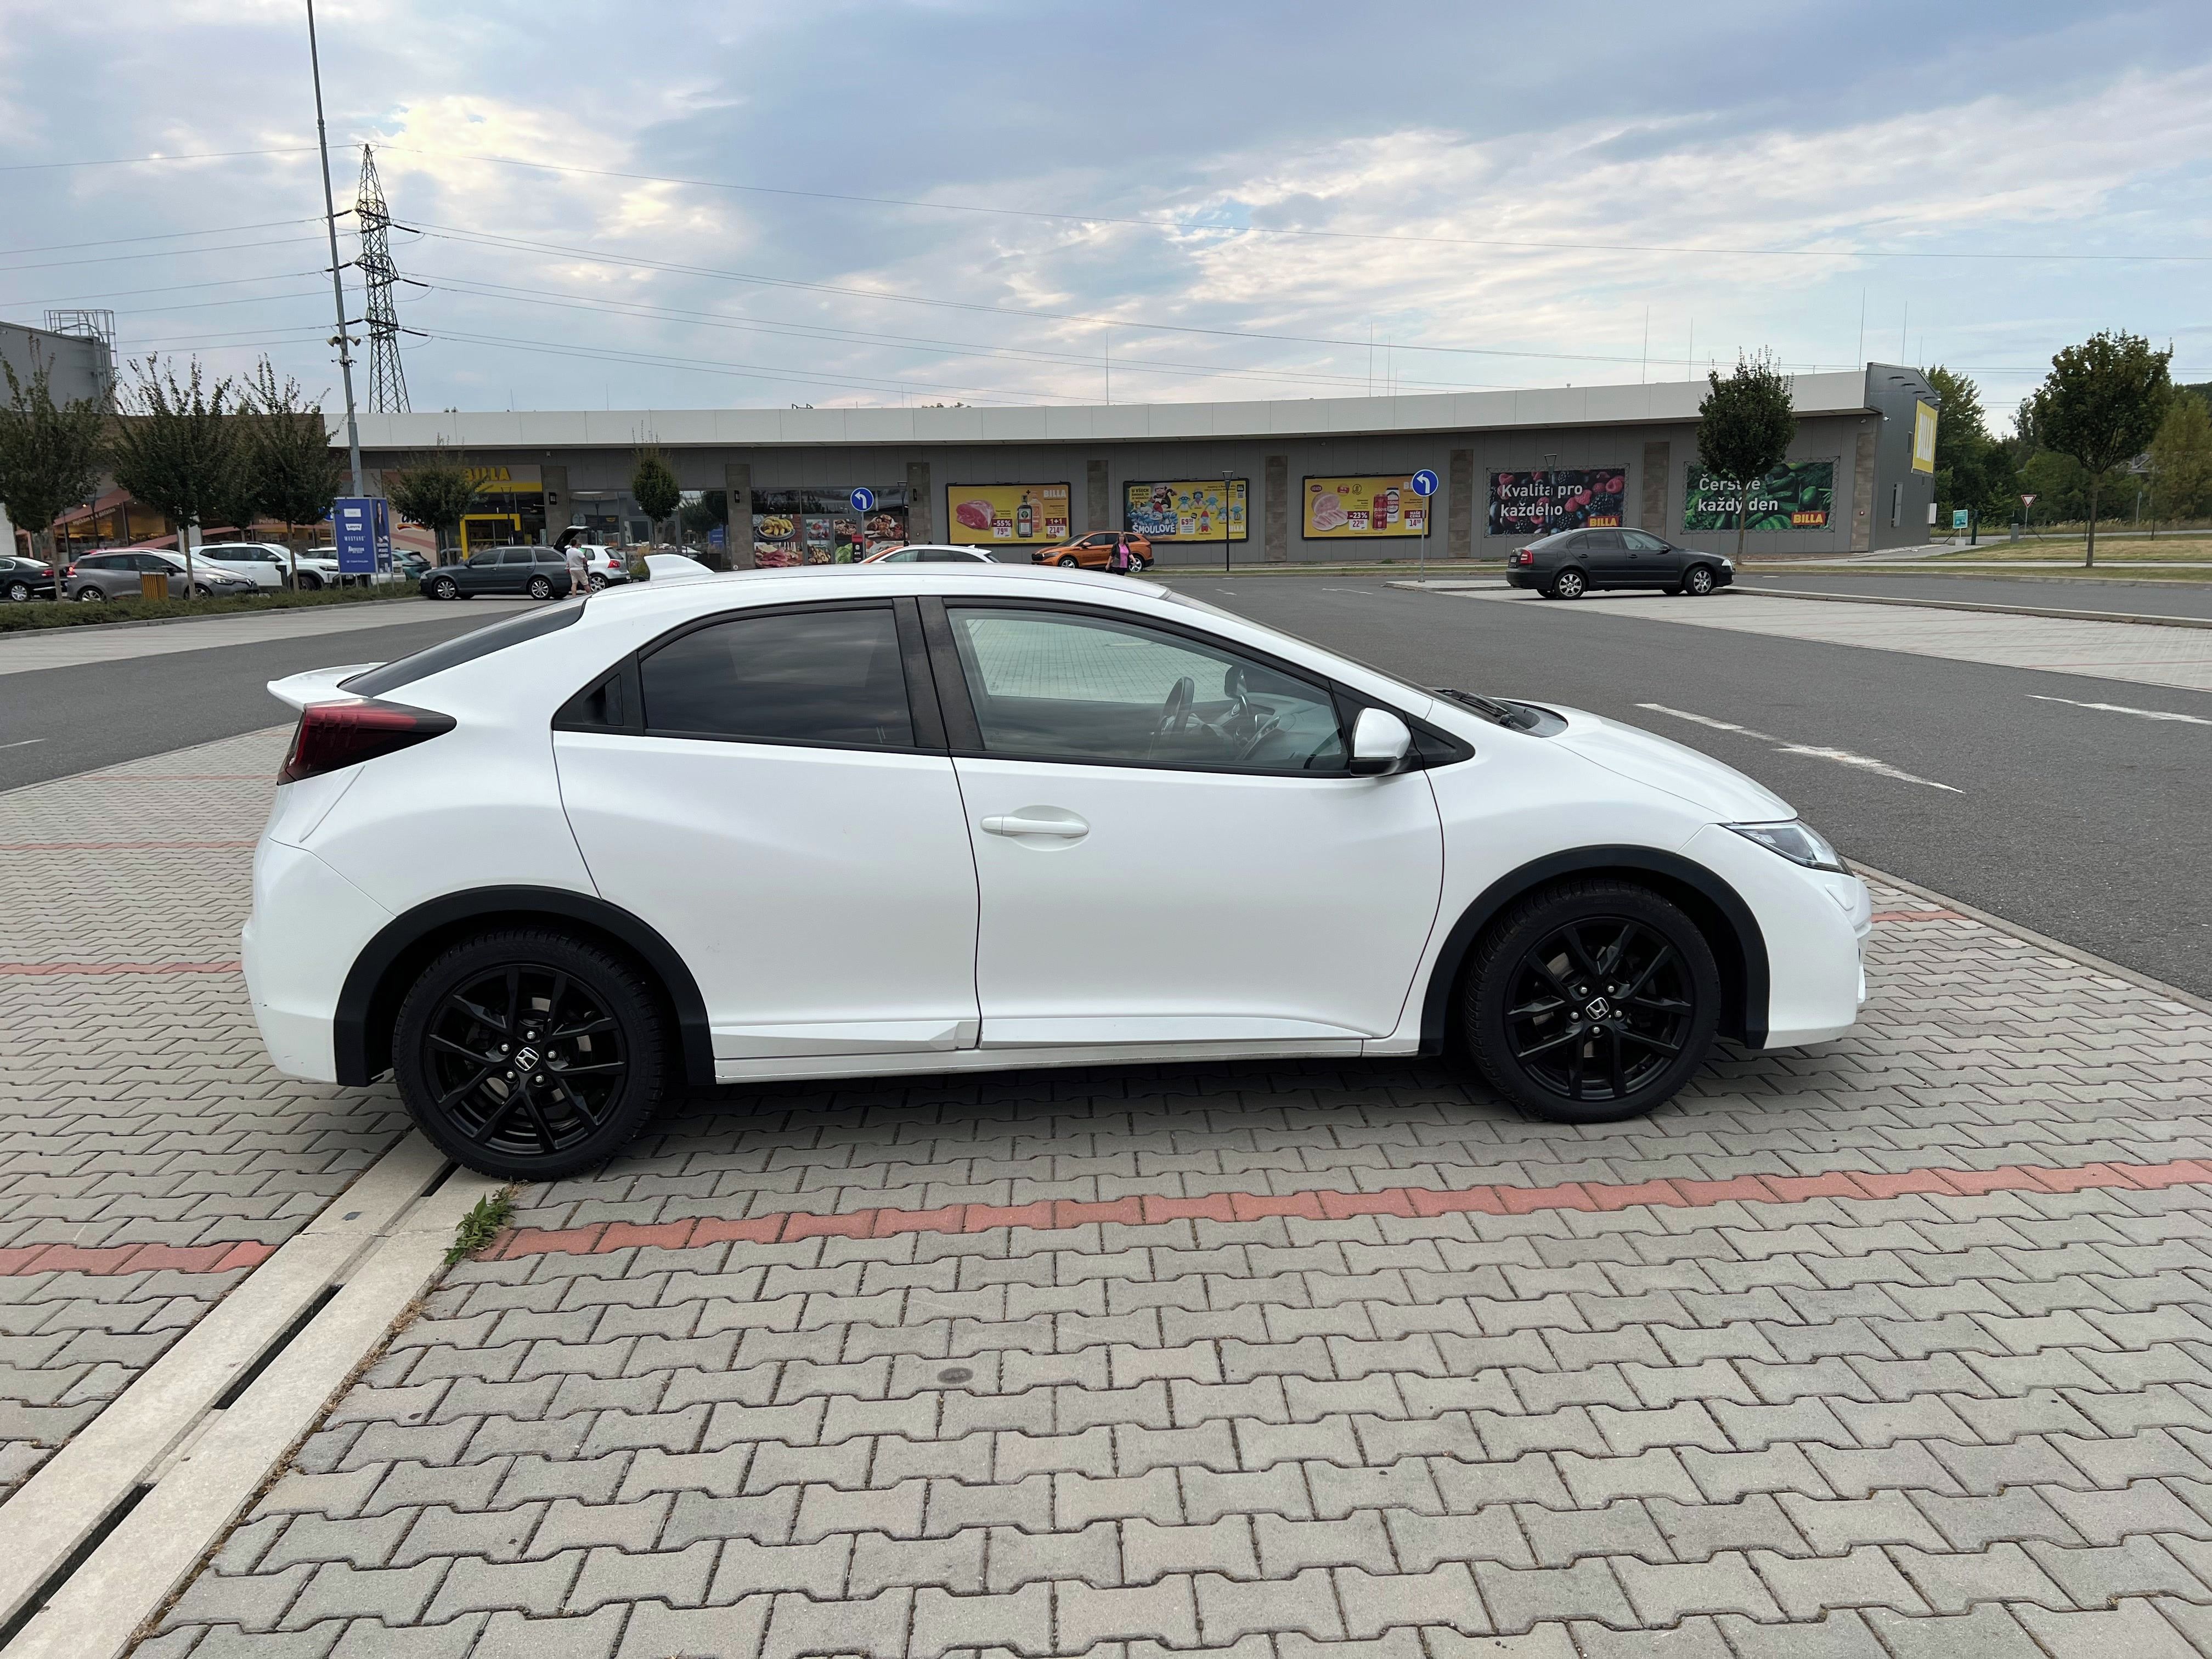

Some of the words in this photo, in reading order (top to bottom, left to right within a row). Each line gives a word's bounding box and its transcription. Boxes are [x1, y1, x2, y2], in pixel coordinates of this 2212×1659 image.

[465, 467, 511, 481] BILLA
[1043, 489, 1066, 498] BILLA
[1502, 484, 1553, 496] Kvalita
[1558, 485, 1583, 498] pro
[1501, 502, 1563, 516] každého
[1699, 497, 1742, 515] každý
[1748, 497, 1778, 511] den
[1589, 518, 1617, 527] BILLA
[1793, 514, 1823, 523] BILLA
[1132, 522, 1175, 534] ŠMOULOVÉ
